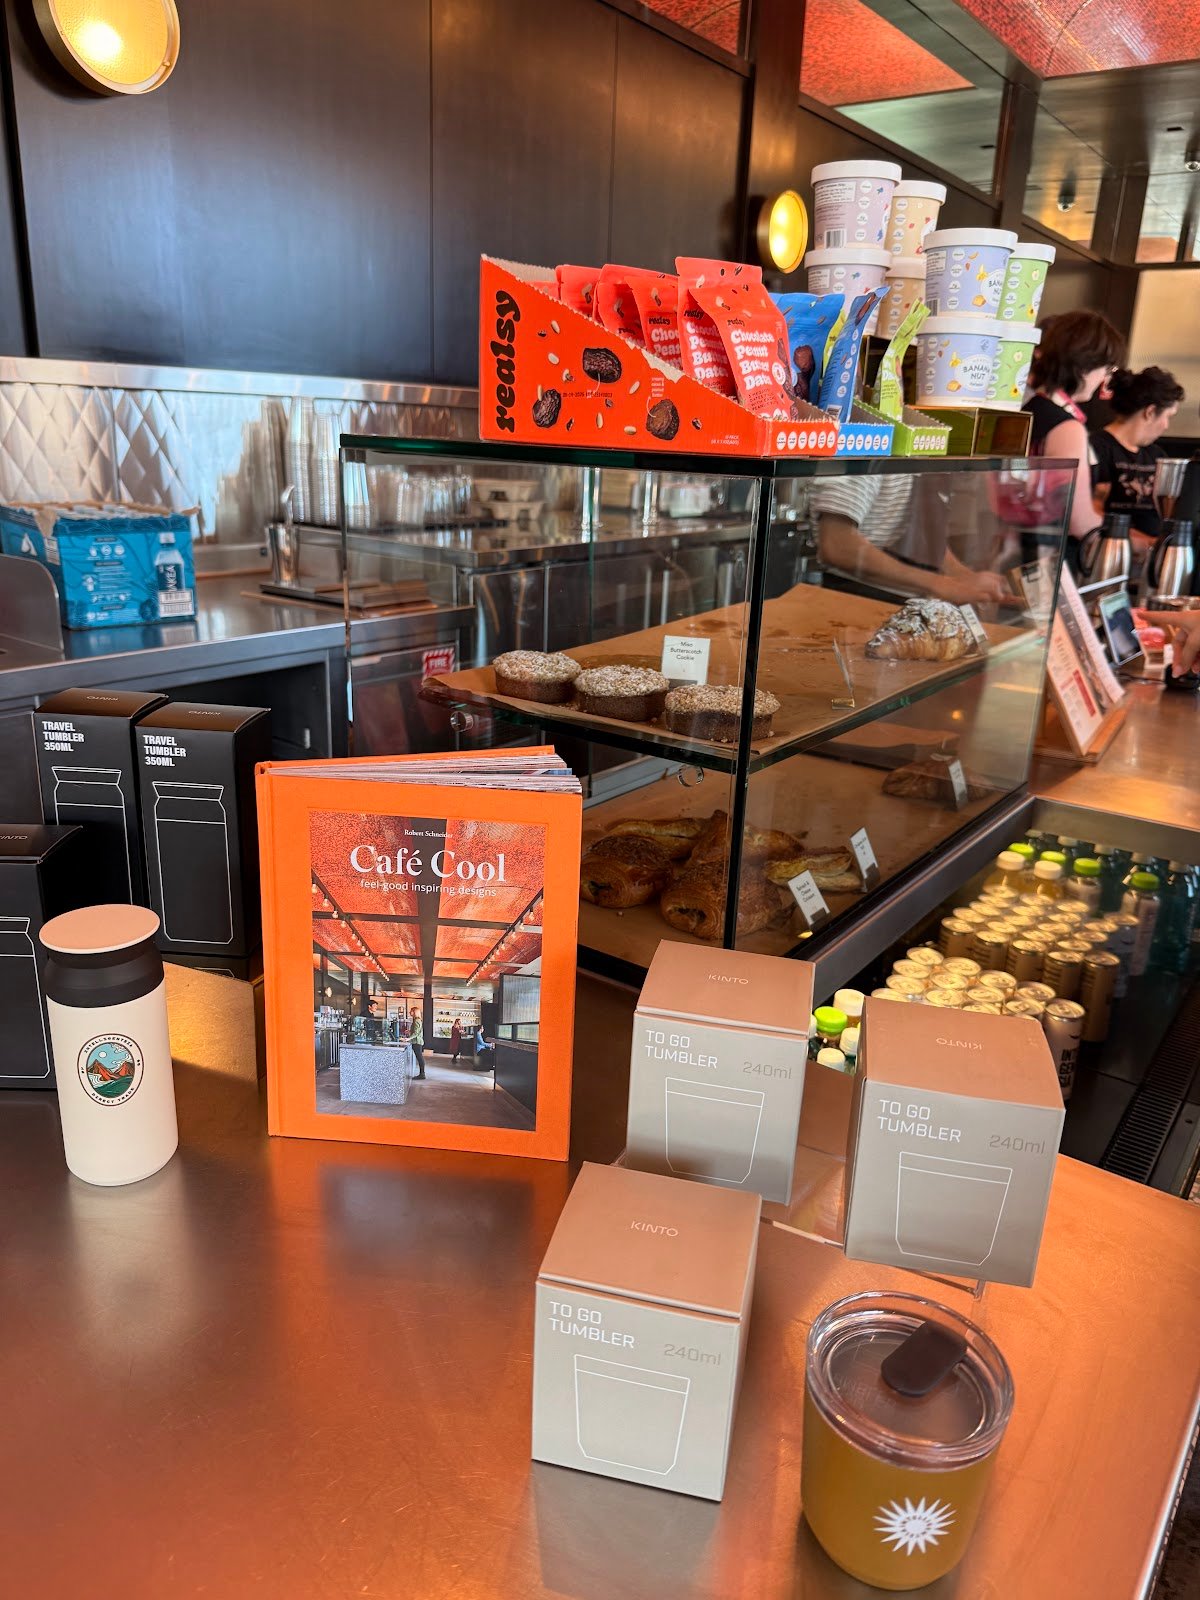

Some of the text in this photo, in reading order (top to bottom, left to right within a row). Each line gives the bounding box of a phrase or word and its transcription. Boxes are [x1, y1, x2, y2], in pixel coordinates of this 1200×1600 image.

[494, 289, 521, 433] realsy
[970, 372, 986, 380] NUT
[670, 647, 703, 655] Butterscotch
[42, 721, 76, 732] TRAVEL
[43, 732, 85, 743] TUMBLER
[142, 735, 177, 746] TRAVEL
[44, 742, 74, 752] 350ML
[144, 745, 187, 757] TUMBLER
[145, 756, 176, 767] 350ML
[404, 829, 453, 838] Robert Schneider
[350, 844, 506, 882] Café Cool
[360, 878, 497, 897] feel-good inspiring designs
[708, 973, 749, 985] KINTO
[645, 1029, 691, 1049] TO GO
[935, 1037, 983, 1050] KINTO
[645, 1045, 793, 1080] TUMBLER 240ml
[91, 1087, 135, 1104] DIRECT TRADE
[879, 1099, 931, 1120] TO GO
[877, 1116, 1046, 1155] TUMBLER 240ml
[630, 1220, 679, 1237] KINTO
[549, 1300, 602, 1325] TO GO
[548, 1317, 722, 1366] TUMBLER 240ml
